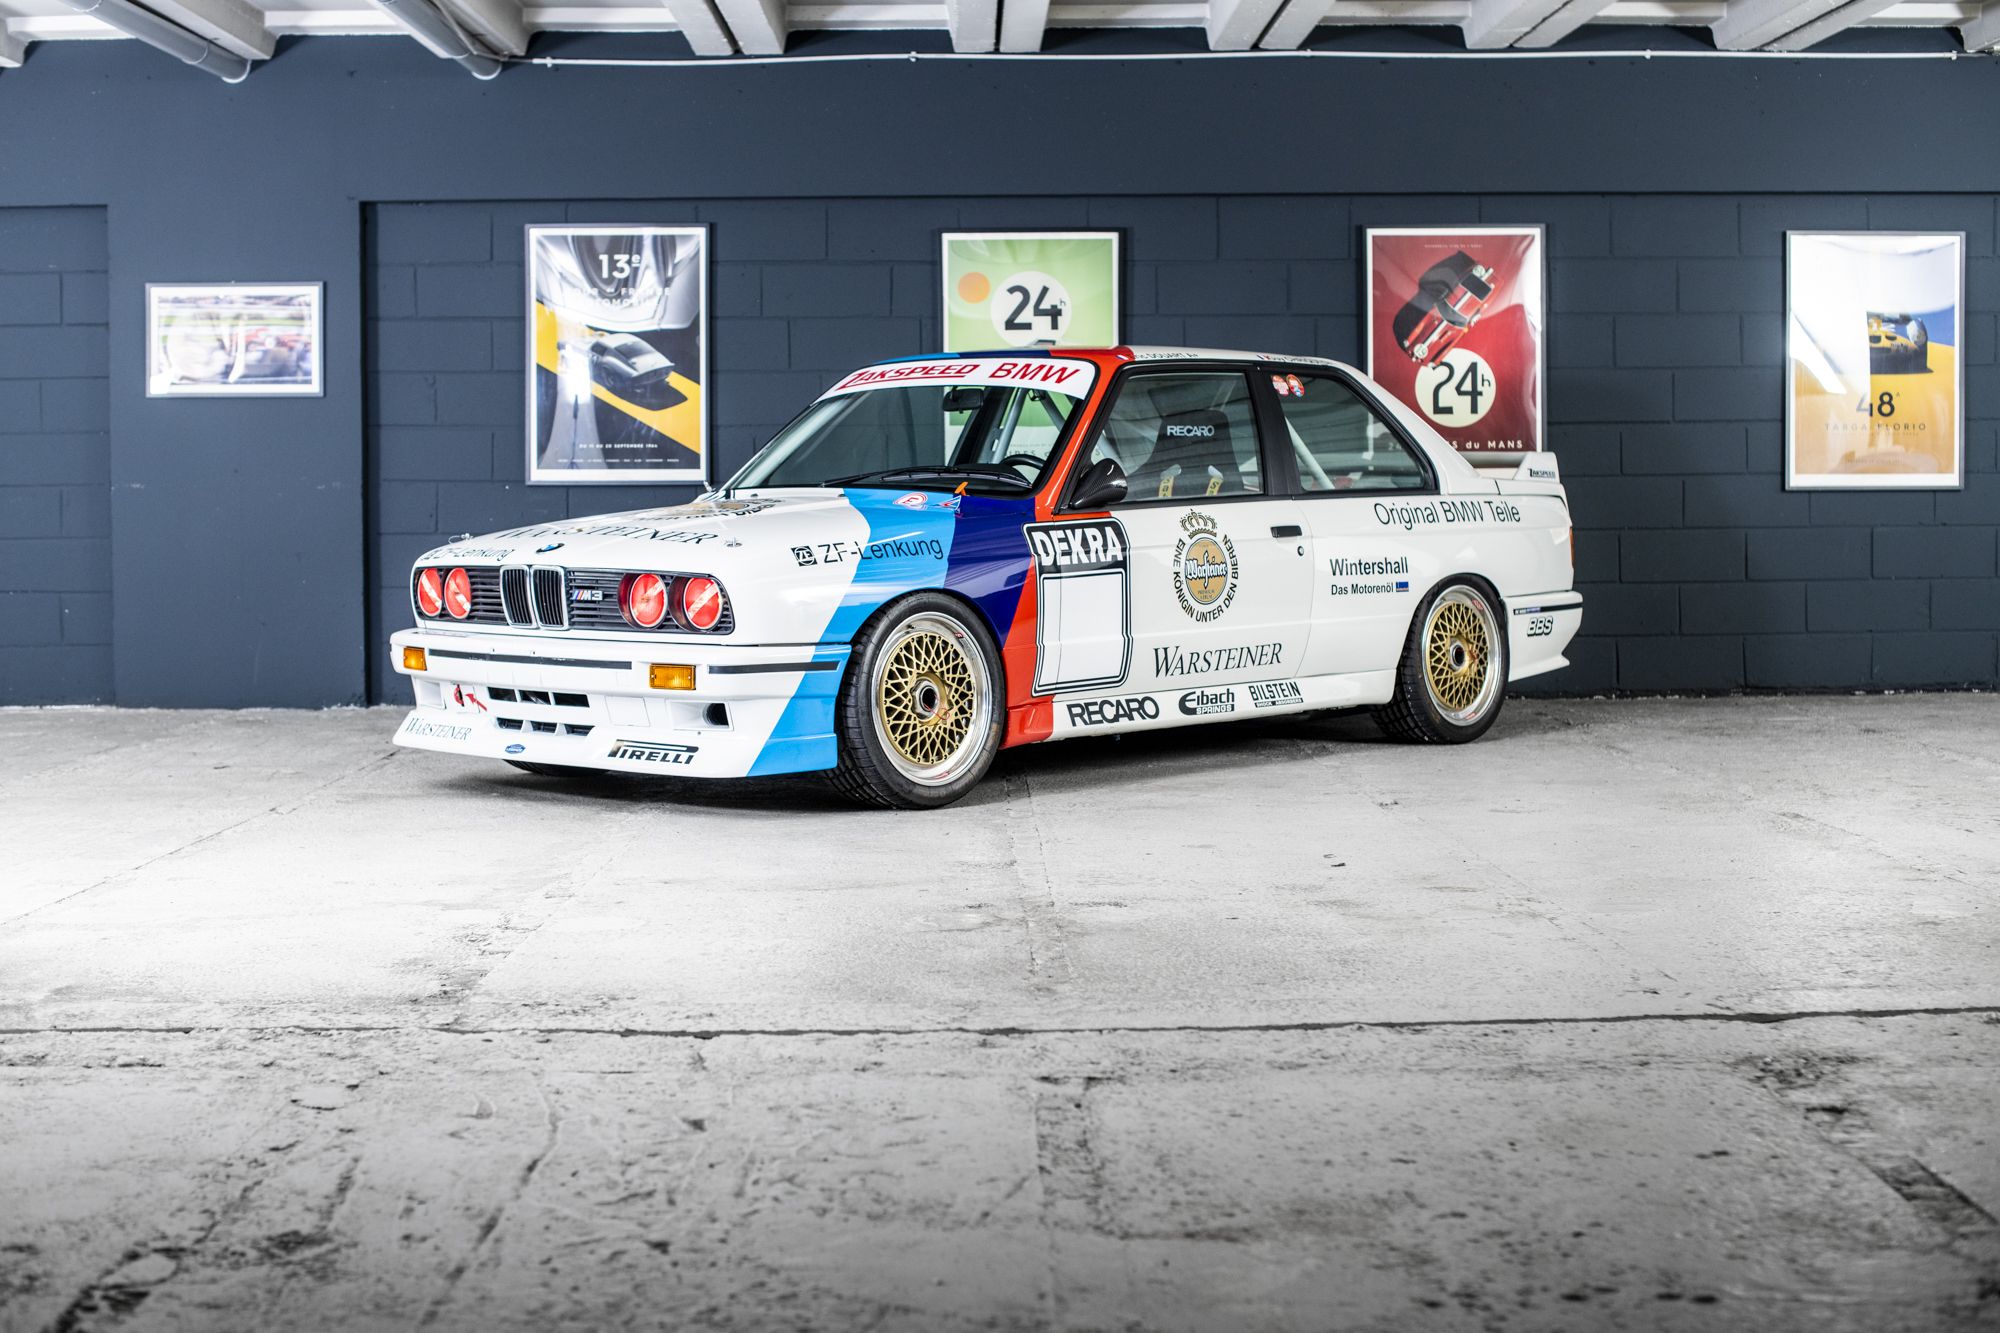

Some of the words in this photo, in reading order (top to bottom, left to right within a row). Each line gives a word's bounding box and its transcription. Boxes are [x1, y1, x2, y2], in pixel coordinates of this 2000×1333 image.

[835, 364, 981, 391] ZAKSPEED
[989, 362, 1081, 384] BMW
[1167, 425, 1215, 437] RECARO
[1825, 423, 1867, 431] TARGA
[1877, 423, 1926, 431] FLORIO
[1466, 440, 1480, 449] du
[1487, 440, 1523, 449] MANS
[1374, 501, 1440, 531] Original
[1440, 501, 1484, 522] BMW
[1484, 501, 1521, 522] Teile
[818, 538, 944, 563] ZF-Lenkung
[1031, 526, 1124, 566] DEKRA
[1173, 538, 1186, 568] EINE
[1222, 534, 1239, 579] BIEREN
[1330, 557, 1408, 576] Wintershall
[576, 590, 603, 600] M3
[1173, 571, 1195, 618] KÖNIGIN
[1225, 582, 1237, 608] DEN
[1331, 584, 1348, 595] Das
[1351, 582, 1394, 594] Motorenöl
[1195, 605, 1224, 622] UNTER
[1527, 616, 1553, 637] BBS
[1153, 642, 1282, 678] WARSTEINER
[1178, 688, 1235, 715] Eibach
[1248, 682, 1301, 701] BILSTEIN
[1067, 696, 1160, 727] RECARO
[1196, 704, 1232, 715] SPRINGS
[405, 718, 472, 740] WARSTEINER
[607, 739, 699, 764] PIRELLI
